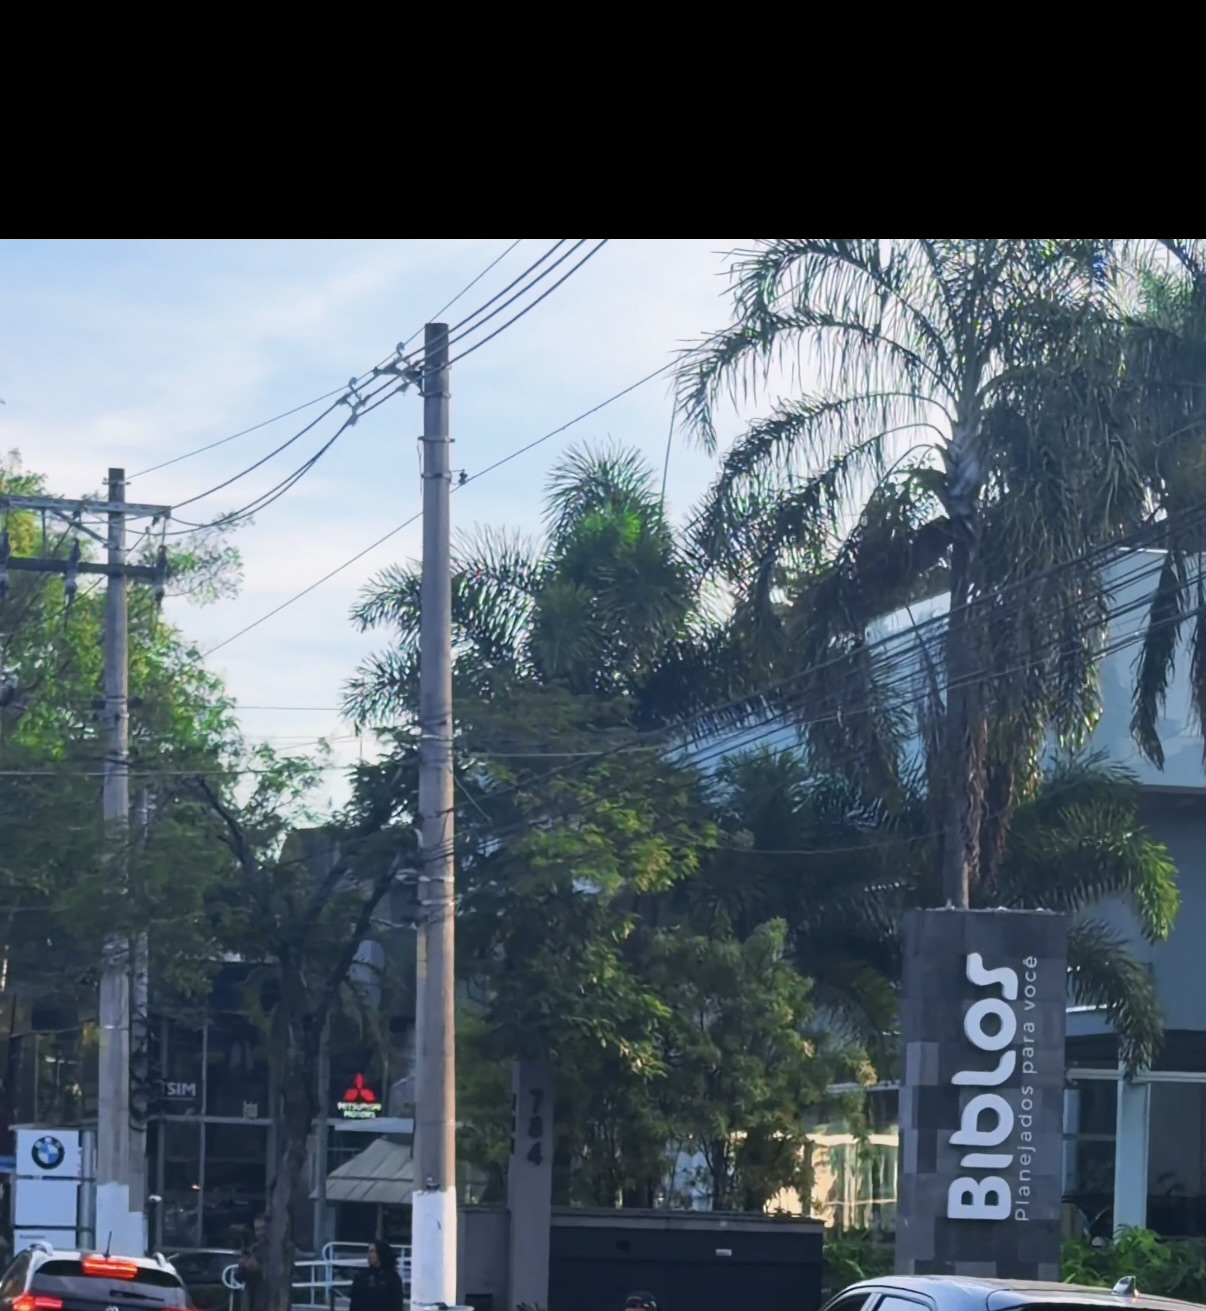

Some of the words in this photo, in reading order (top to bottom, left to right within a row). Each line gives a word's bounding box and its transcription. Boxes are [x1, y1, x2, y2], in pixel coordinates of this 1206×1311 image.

[1022, 955, 1038, 1011] você
[1022, 1022, 1038, 1074] para
[1014, 1085, 1036, 1221] Planejados
